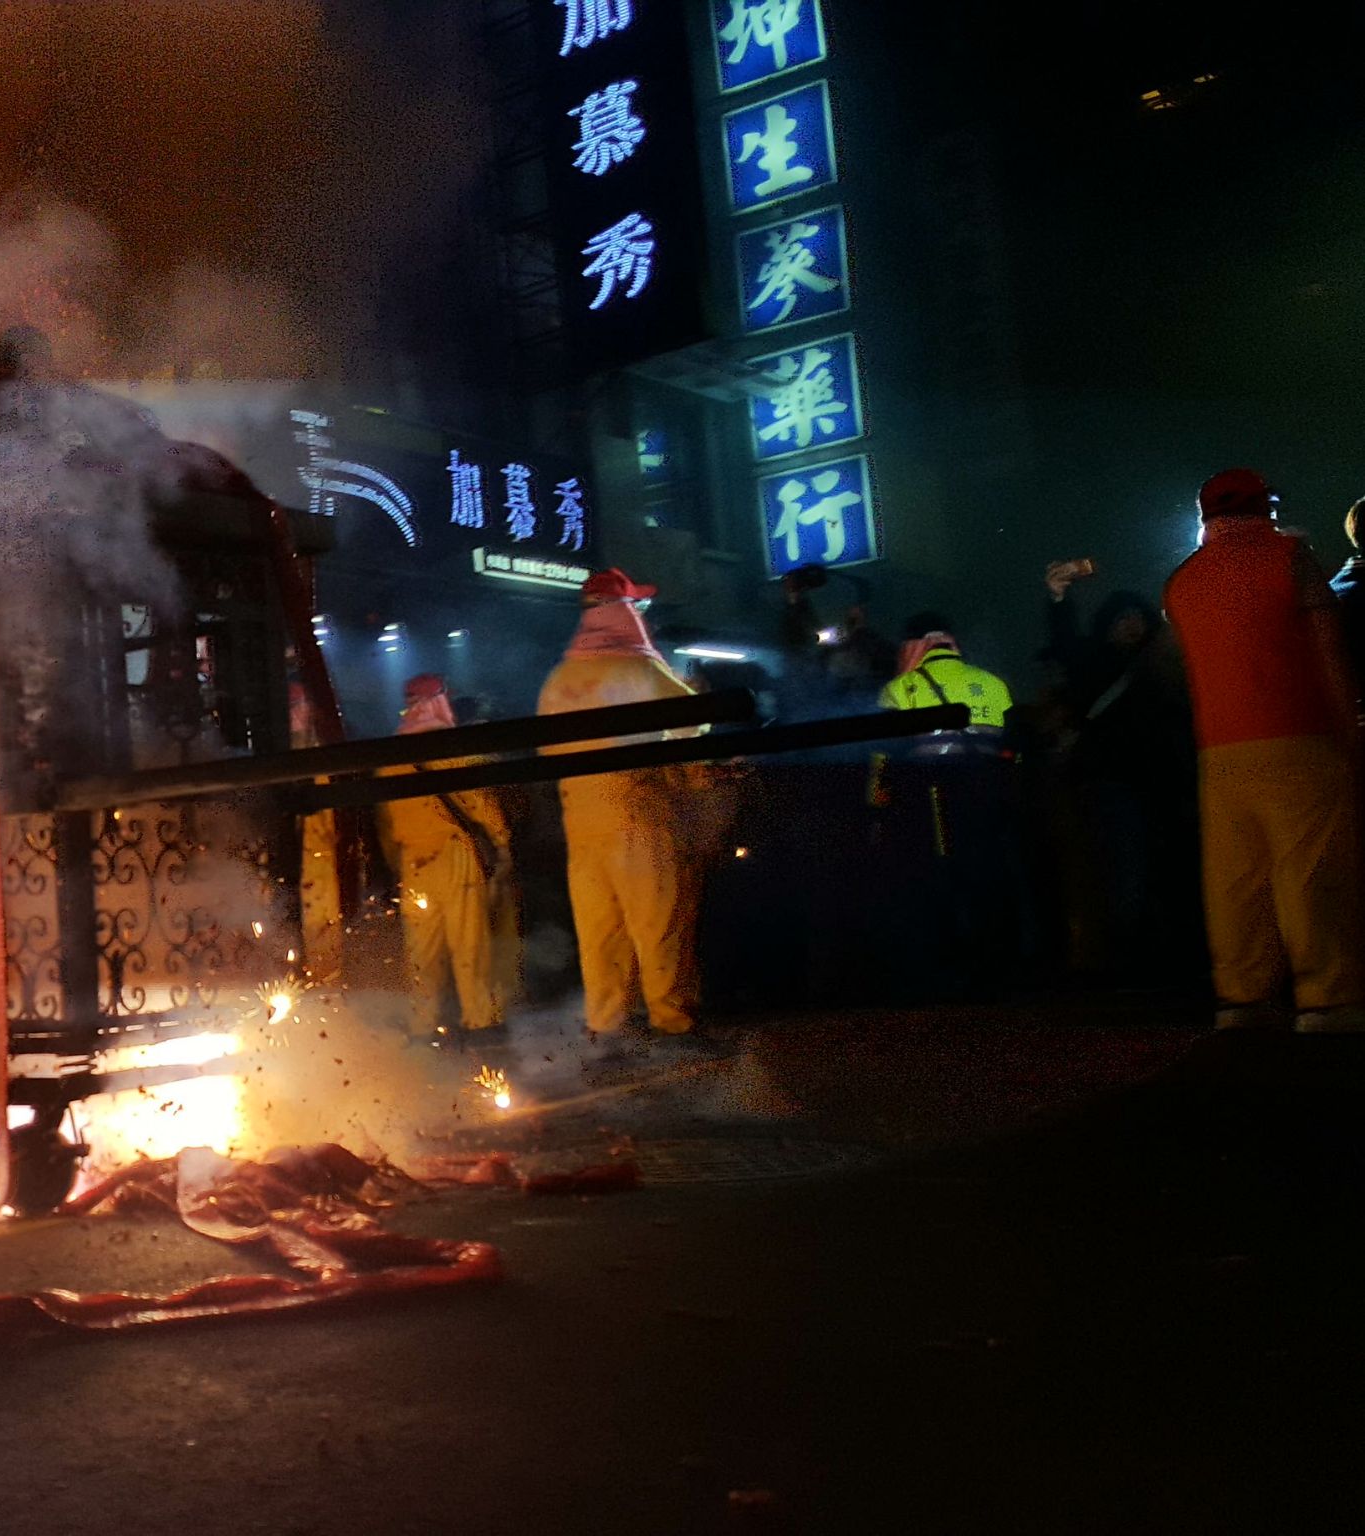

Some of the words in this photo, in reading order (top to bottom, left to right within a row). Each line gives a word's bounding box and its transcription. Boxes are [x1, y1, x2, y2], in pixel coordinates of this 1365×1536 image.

[552, 0, 655, 311] 加慕秀
[445, 448, 585, 552] 加慕秀
